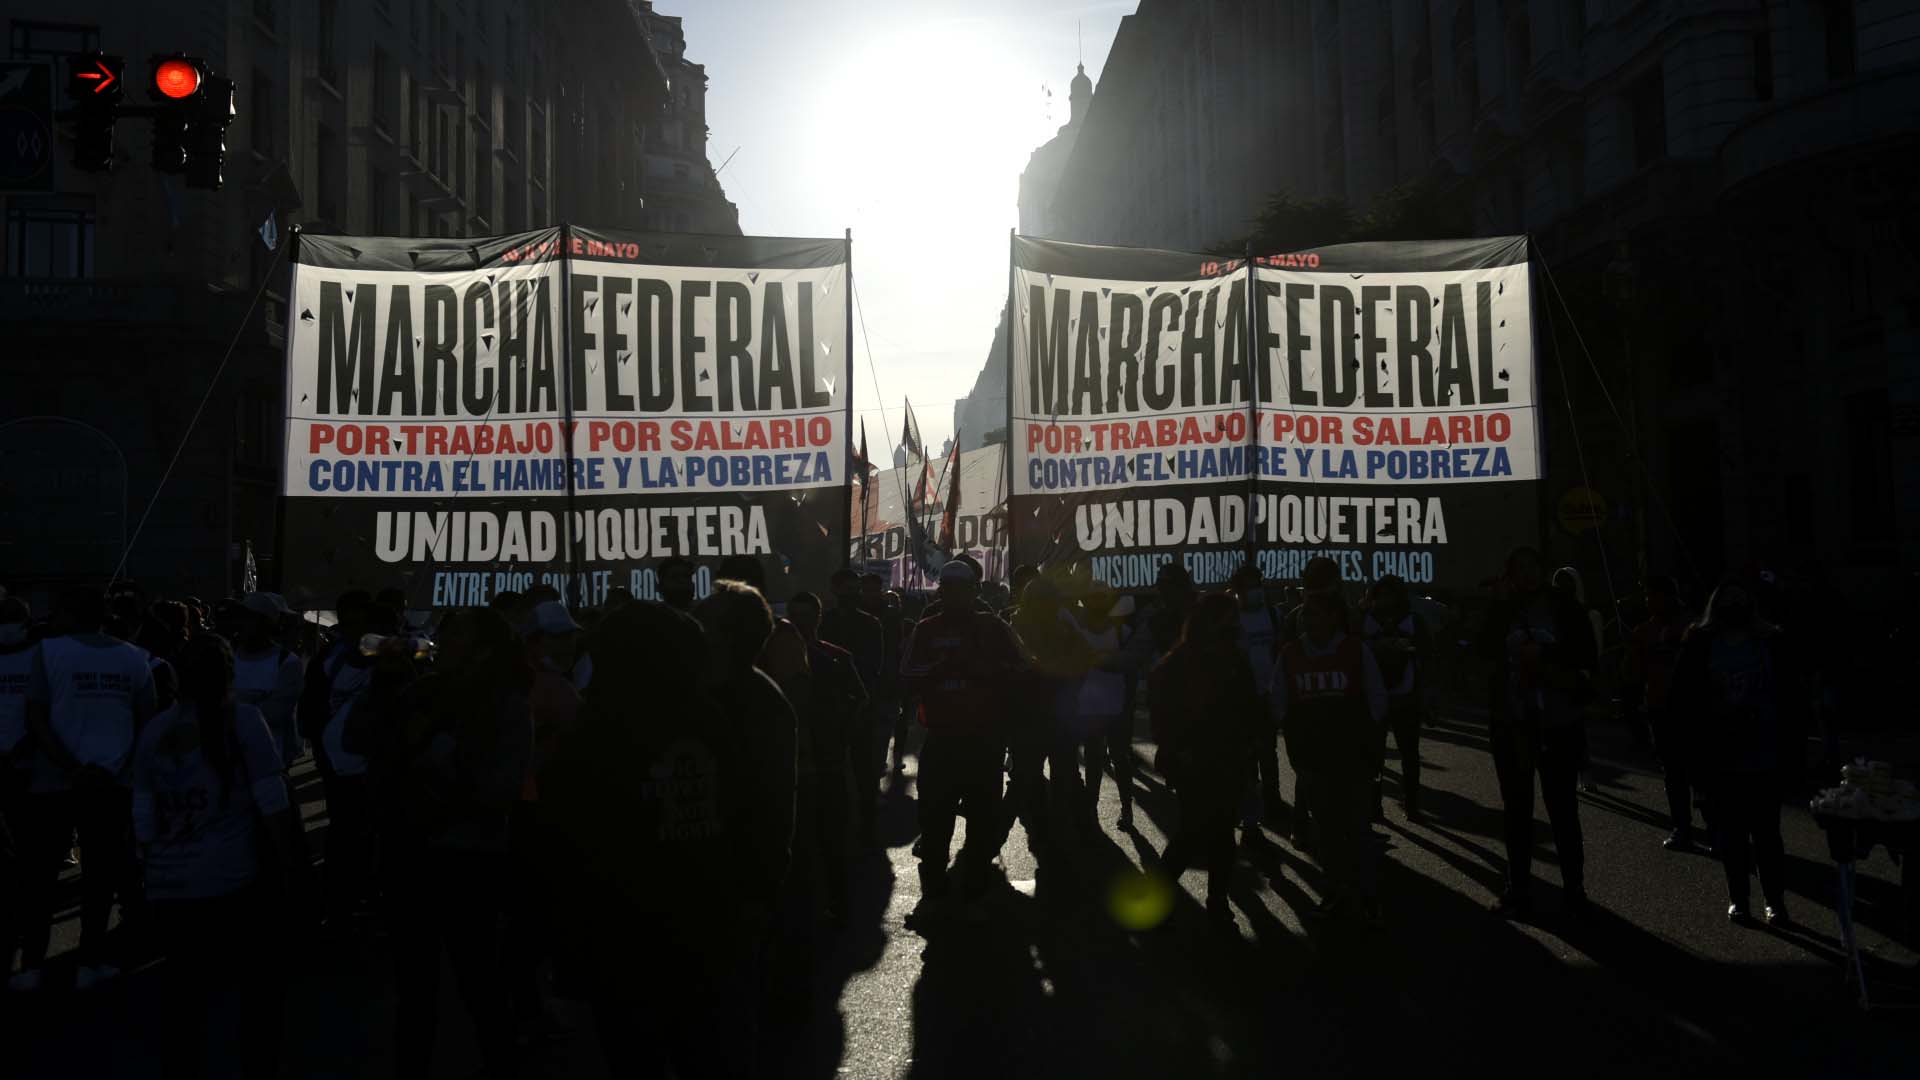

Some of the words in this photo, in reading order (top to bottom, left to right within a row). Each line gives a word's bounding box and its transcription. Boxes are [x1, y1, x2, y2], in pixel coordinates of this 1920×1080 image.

[587, 240, 640, 260] MAYO
[1269, 253, 1321, 269] MAYO
[316, 276, 557, 417] MARCHA
[570, 274, 831, 413] FEDERAL
[1028, 279, 1250, 415] MARCHA
[1254, 280, 1510, 409] FEDERAL
[309, 424, 390, 455] POR
[400, 422, 553, 455] TRABAJO
[589, 420, 661, 451] POR
[670, 416, 832, 450] SALARIO
[1028, 424, 1082, 453] POR
[1091, 412, 1246, 452] TRABAJO
[1273, 413, 1344, 444] POR
[1352, 412, 1512, 446] SALARIO
[309, 459, 444, 491] CONTRA
[452, 459, 486, 491] EL
[493, 456, 605, 491] HAMBRE
[613, 457, 632, 489] Y
[640, 456, 678, 489] LA
[685, 451, 832, 487] POBREZA
[1029, 455, 1128, 489] CONTRA
[1136, 452, 1169, 481] EL
[1294, 448, 1315, 477] Y
[1322, 450, 1359, 479] LA
[1366, 446, 1512, 480] POBREZA
[375, 510, 557, 562] UNIDAD
[563, 505, 771, 562] PIQUETERA
[1075, 495, 1246, 551] UNIDAD
[1248, 490, 1448, 544] PIQUETERA
[432, 571, 491, 608] ENTRE
[630, 565, 711, 602] ROIO
[1256, 549, 1368, 584] CORRITES,
[1373, 551, 1433, 583] CHACO
